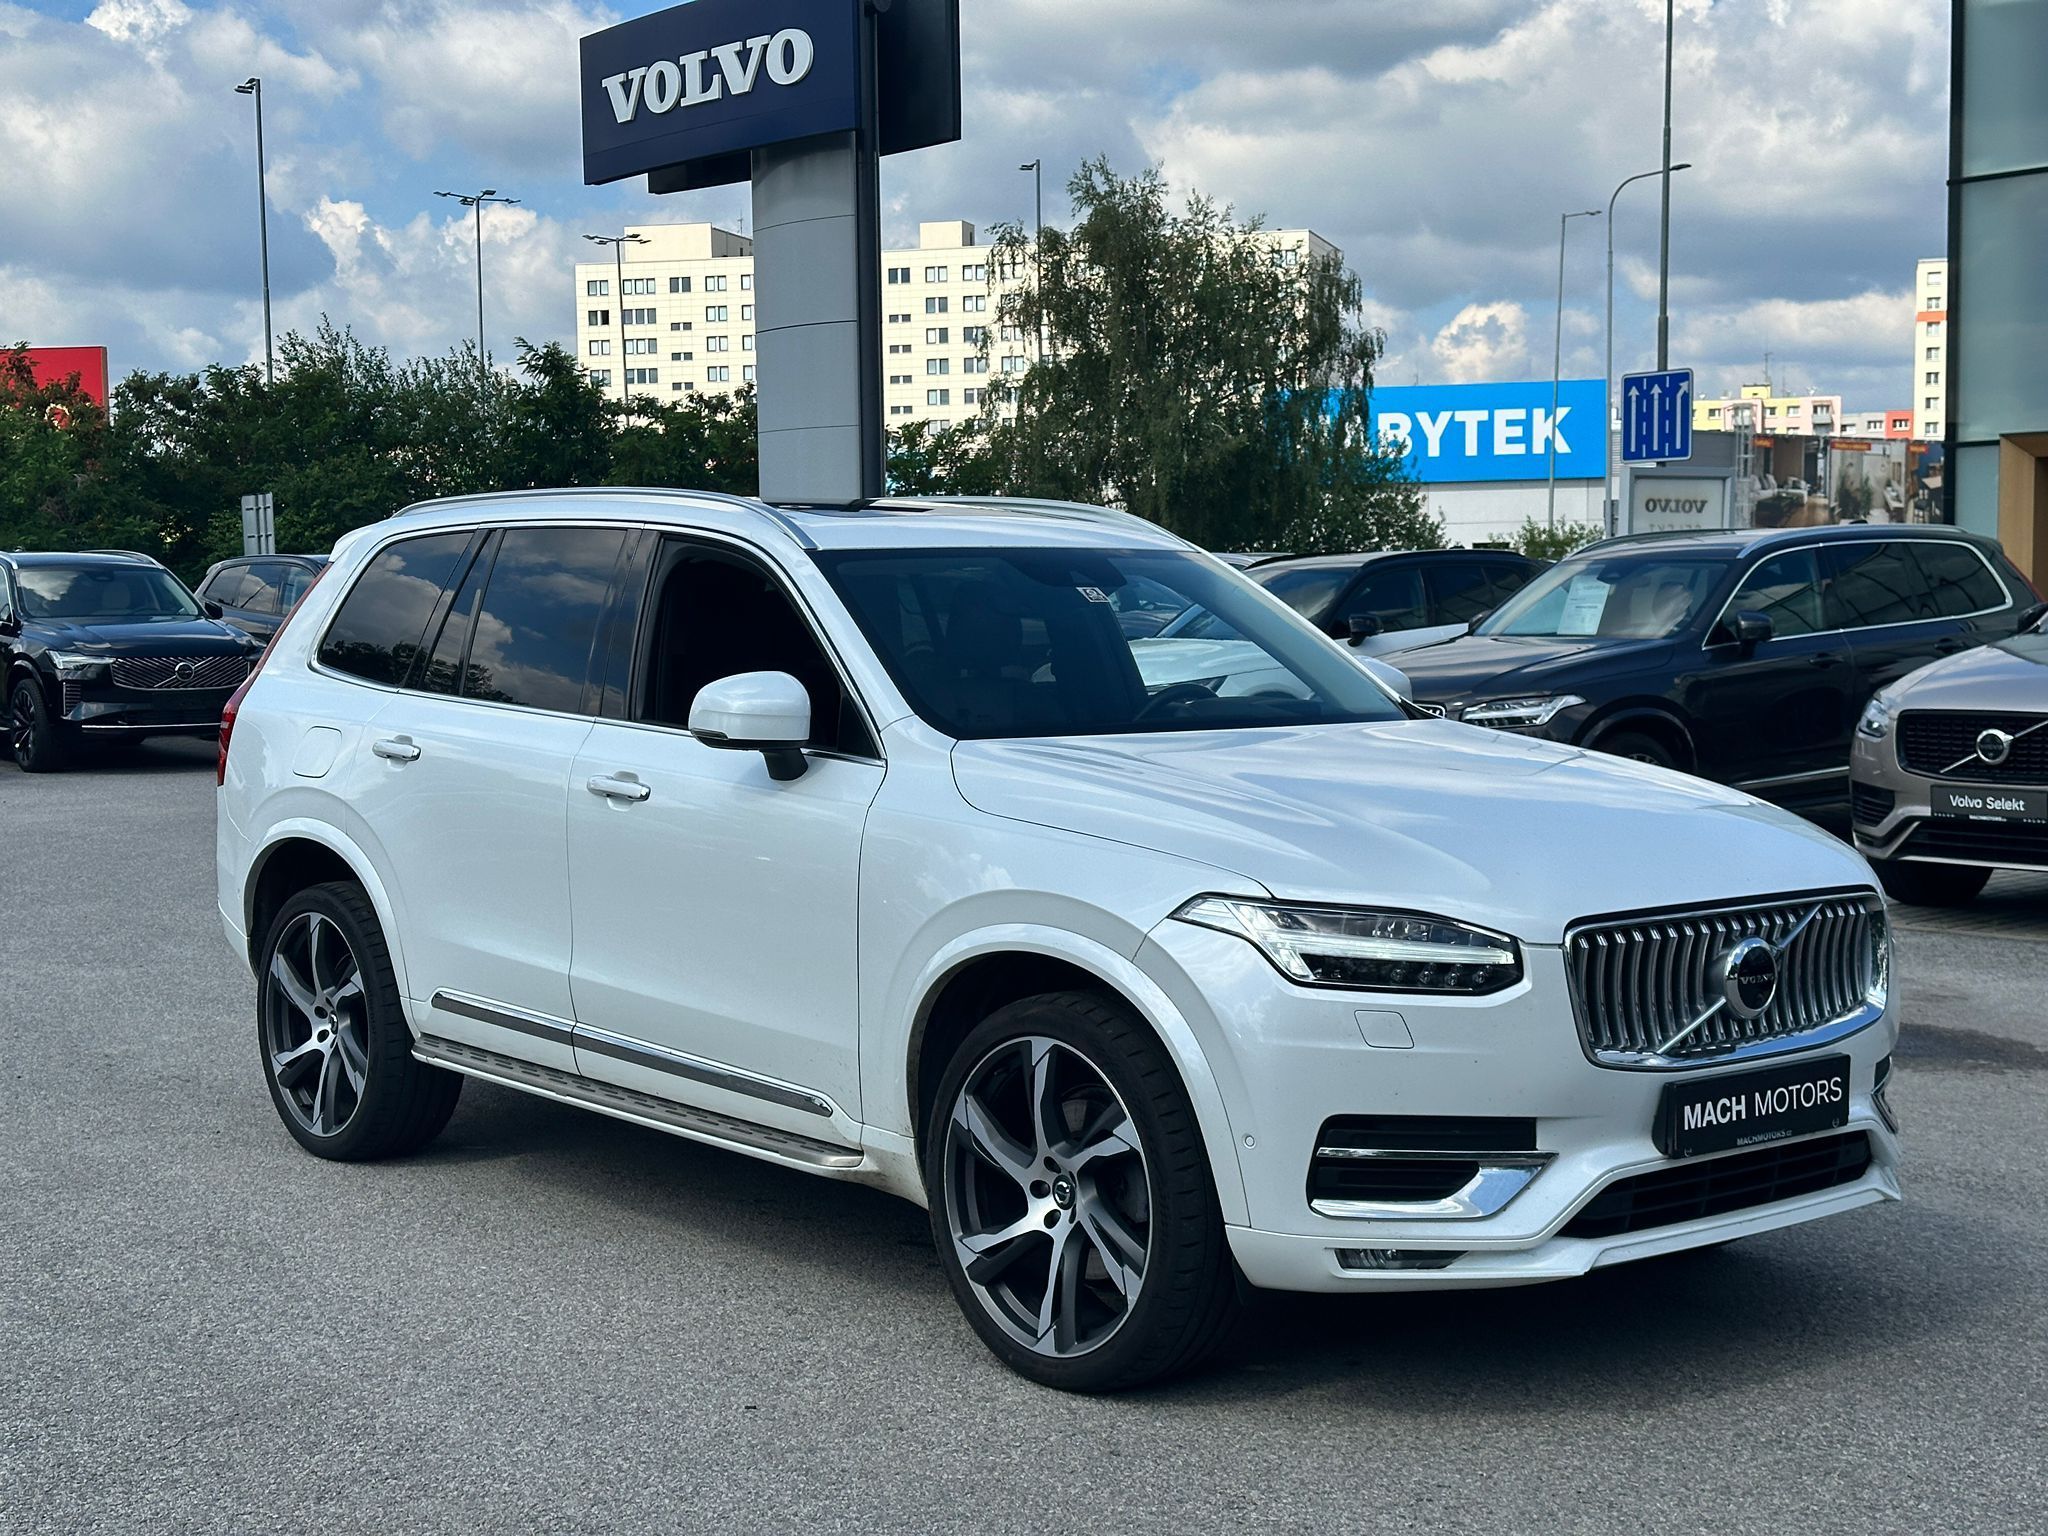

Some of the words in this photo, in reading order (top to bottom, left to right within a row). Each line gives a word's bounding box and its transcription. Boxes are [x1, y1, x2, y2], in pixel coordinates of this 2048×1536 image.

[602, 28, 814, 123] VOLVO
[1298, 406, 1572, 459] BYTEK
[1949, 794, 1983, 809] Volvo
[1986, 797, 2026, 812] Selekt
[1683, 1095, 1747, 1131] MACH
[1754, 1076, 1843, 1118] MOTORS
